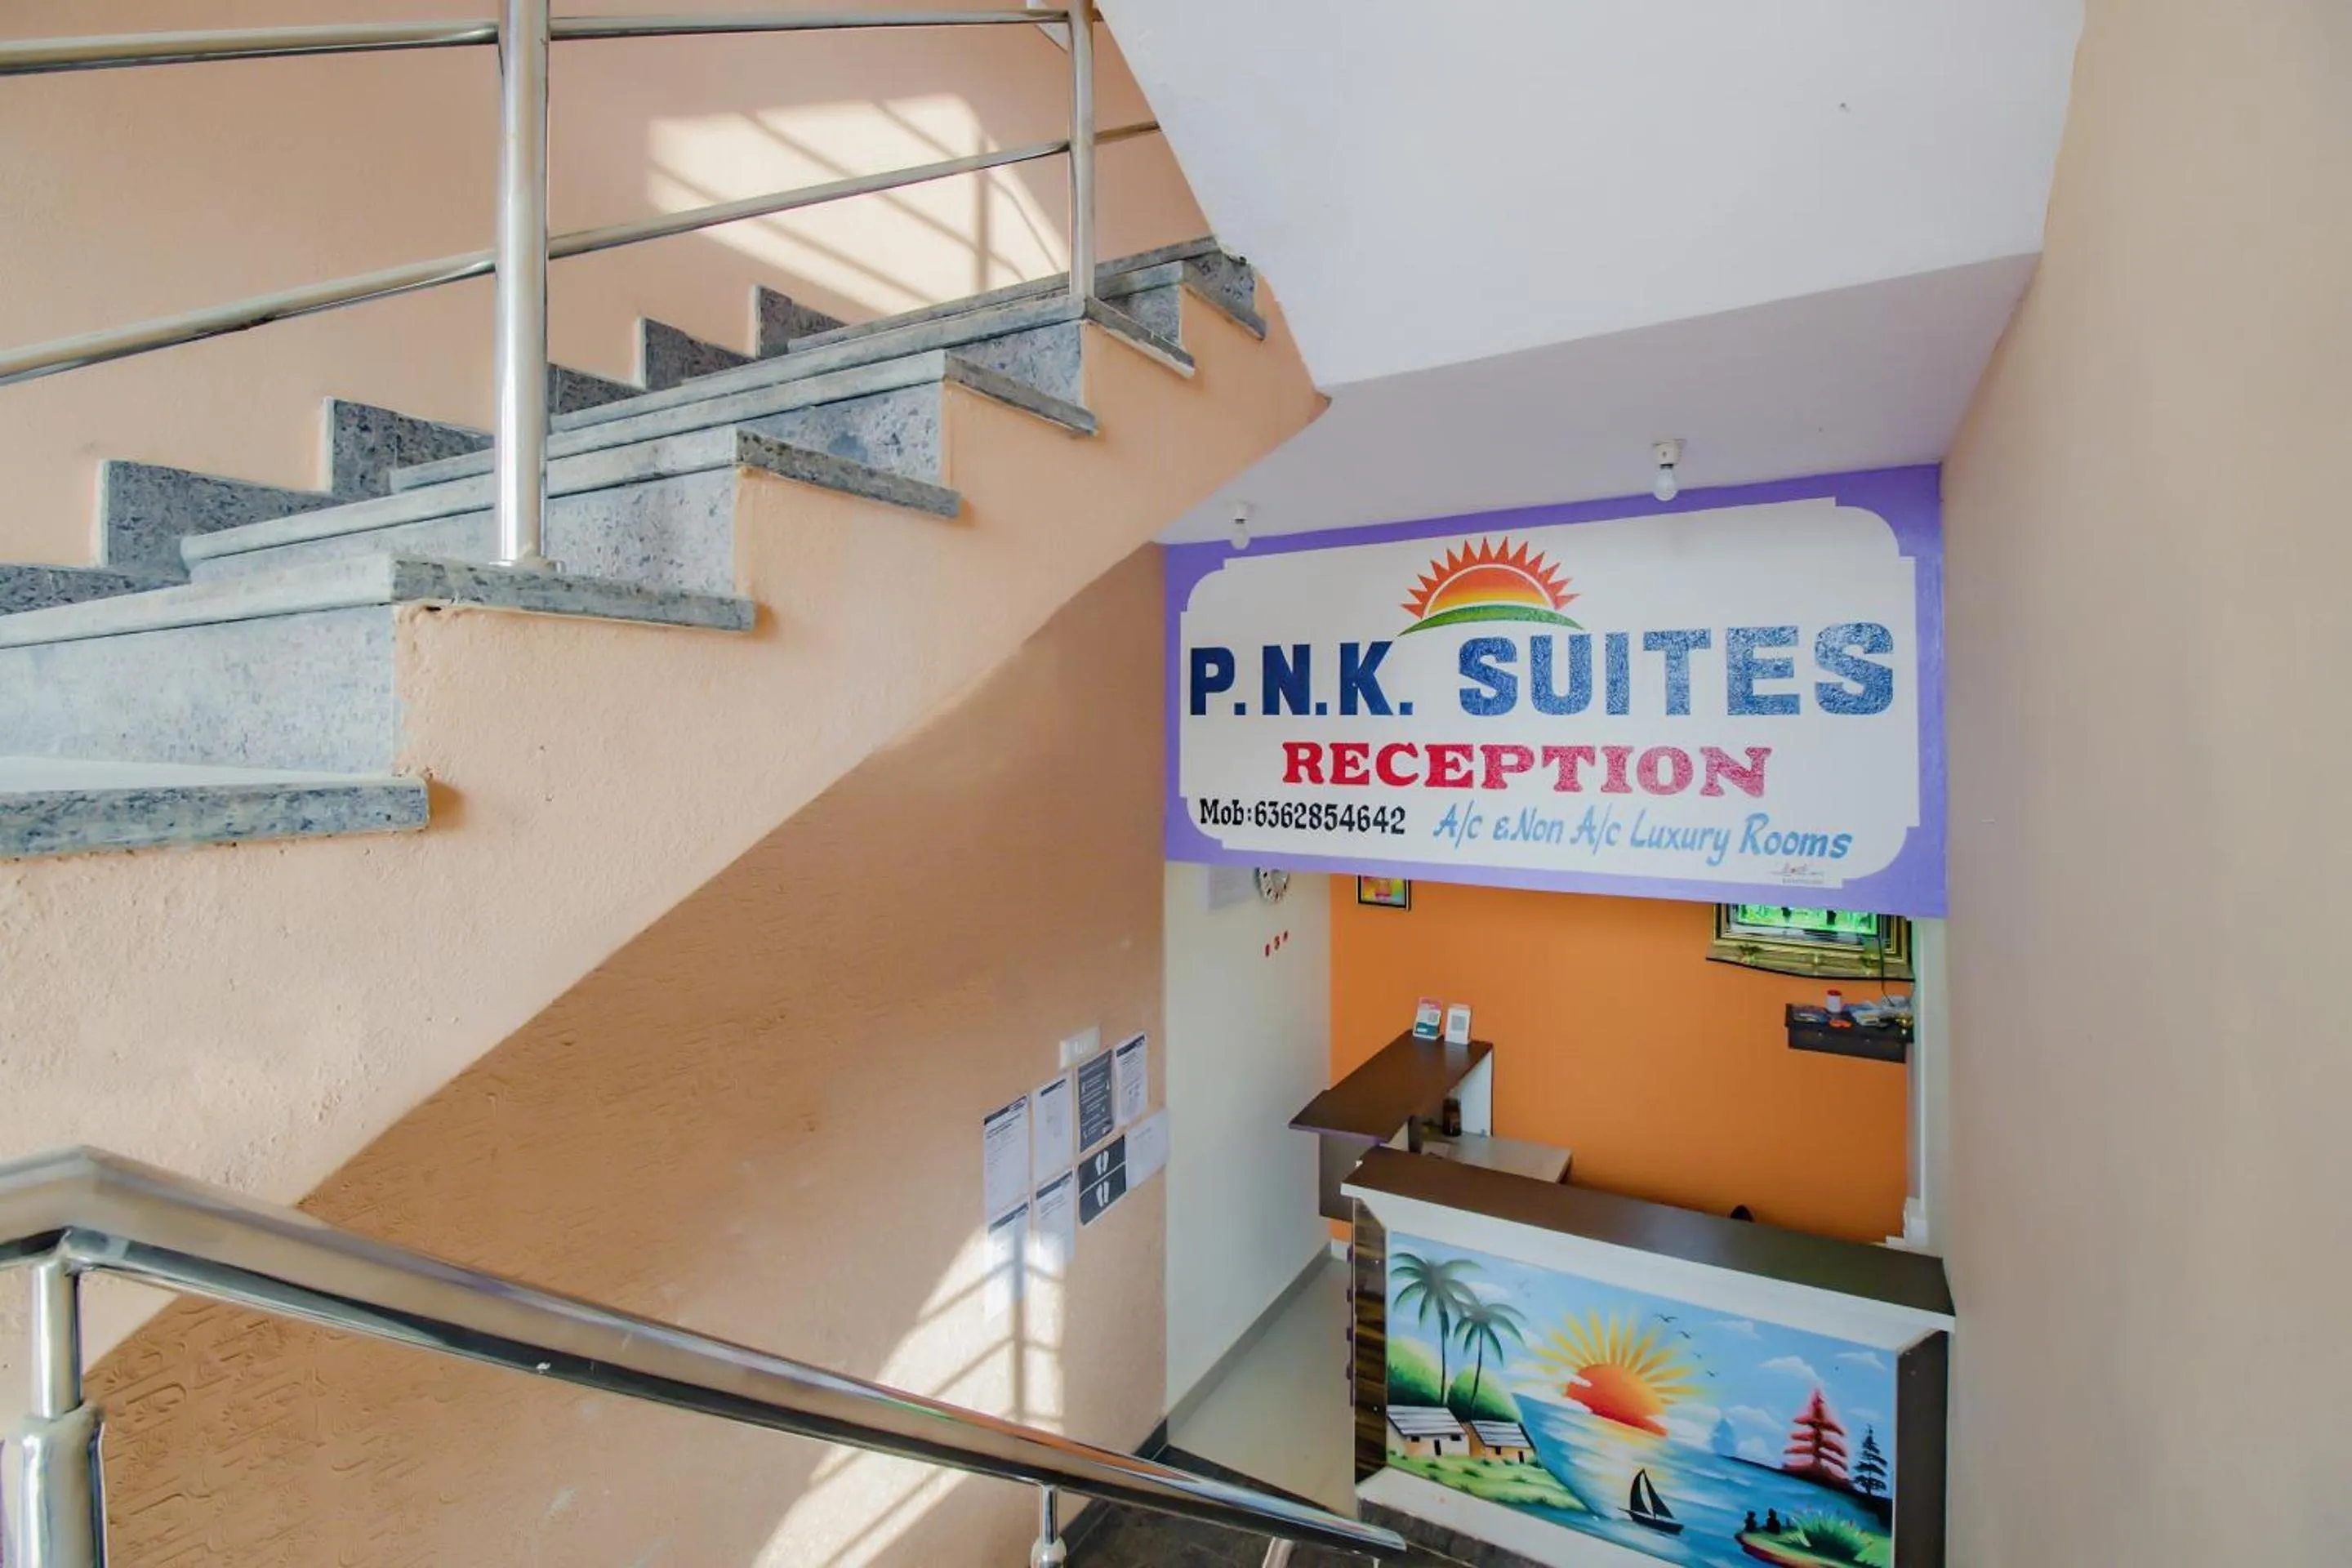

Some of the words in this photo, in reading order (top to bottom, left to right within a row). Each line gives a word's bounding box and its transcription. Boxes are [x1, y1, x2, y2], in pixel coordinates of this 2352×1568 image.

[1190, 642, 1414, 716] P.N.K.
[1459, 622, 1894, 716] SUITES
[1282, 742, 1772, 797] RECEPTION
[1433, 800, 1483, 849] A/c
[1570, 803, 1622, 854] A/c
[1630, 808, 1731, 866] Luxury
[1739, 813, 1853, 858] Rooms
